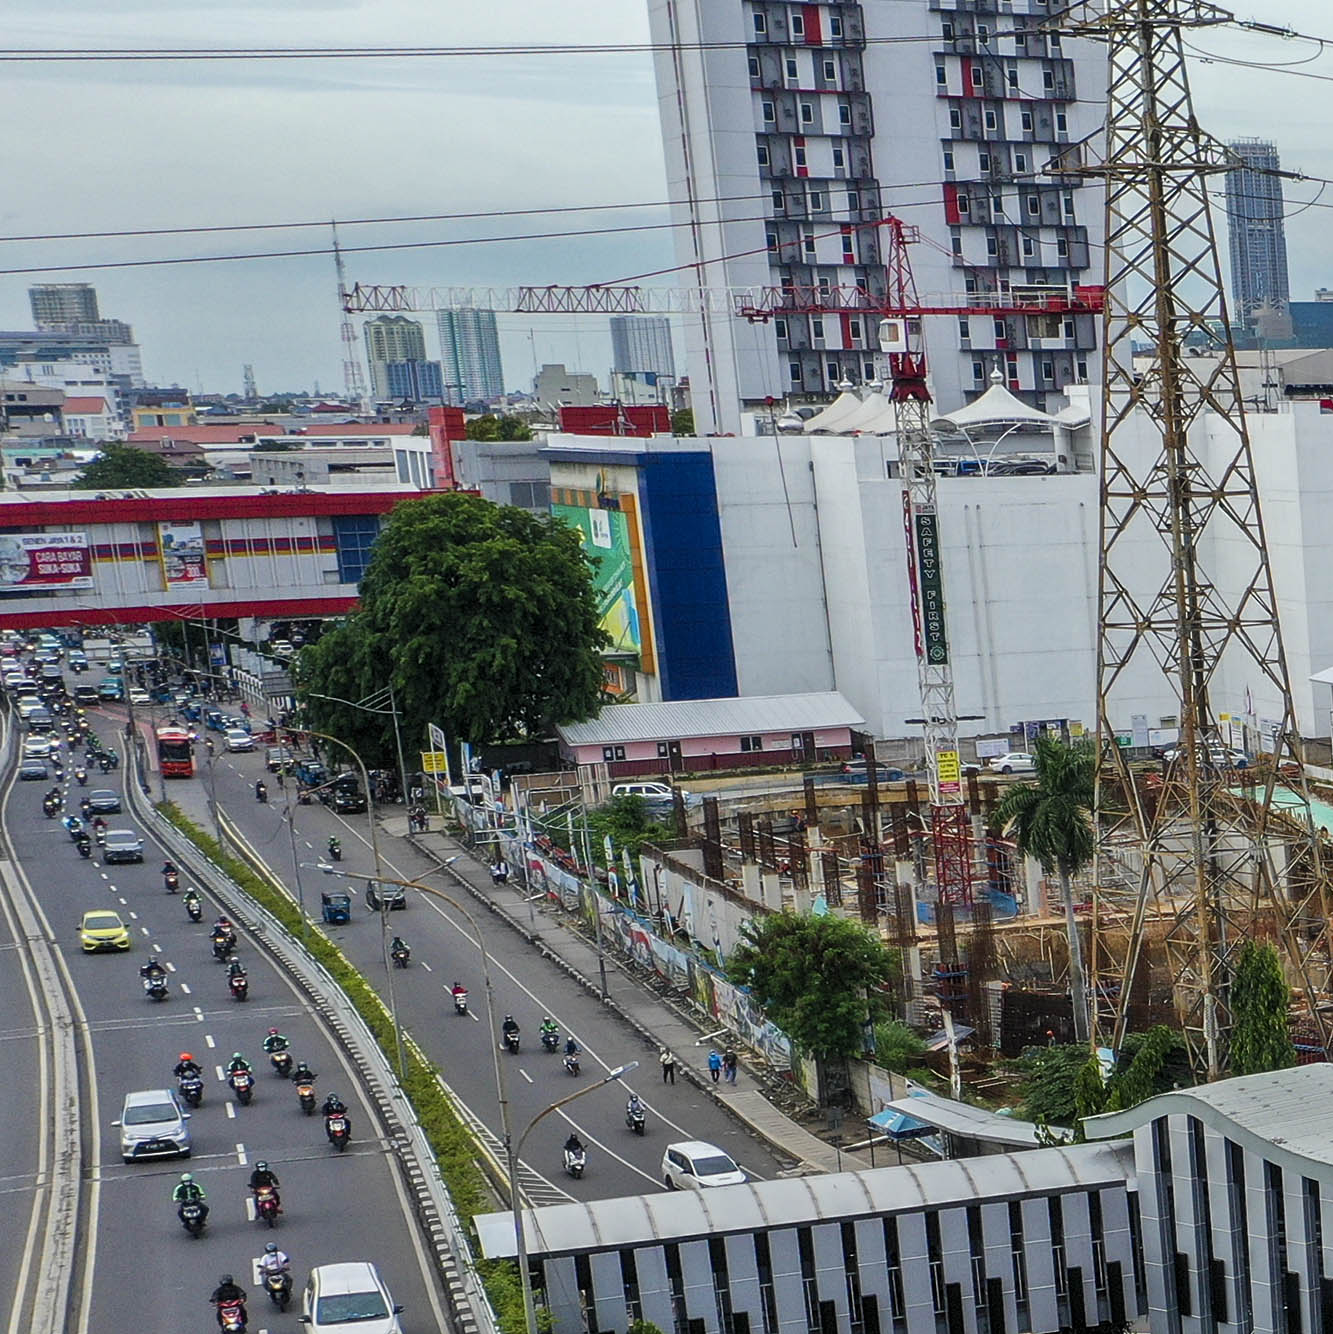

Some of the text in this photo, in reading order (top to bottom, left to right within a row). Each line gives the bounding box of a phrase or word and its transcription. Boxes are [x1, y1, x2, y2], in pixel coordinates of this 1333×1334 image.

[35, 550, 83, 563] CARA BAYAR
[920, 516, 936, 579] SAFETY
[38, 563, 81, 575] SUKA-SUKA
[926, 590, 940, 642] FIRST
